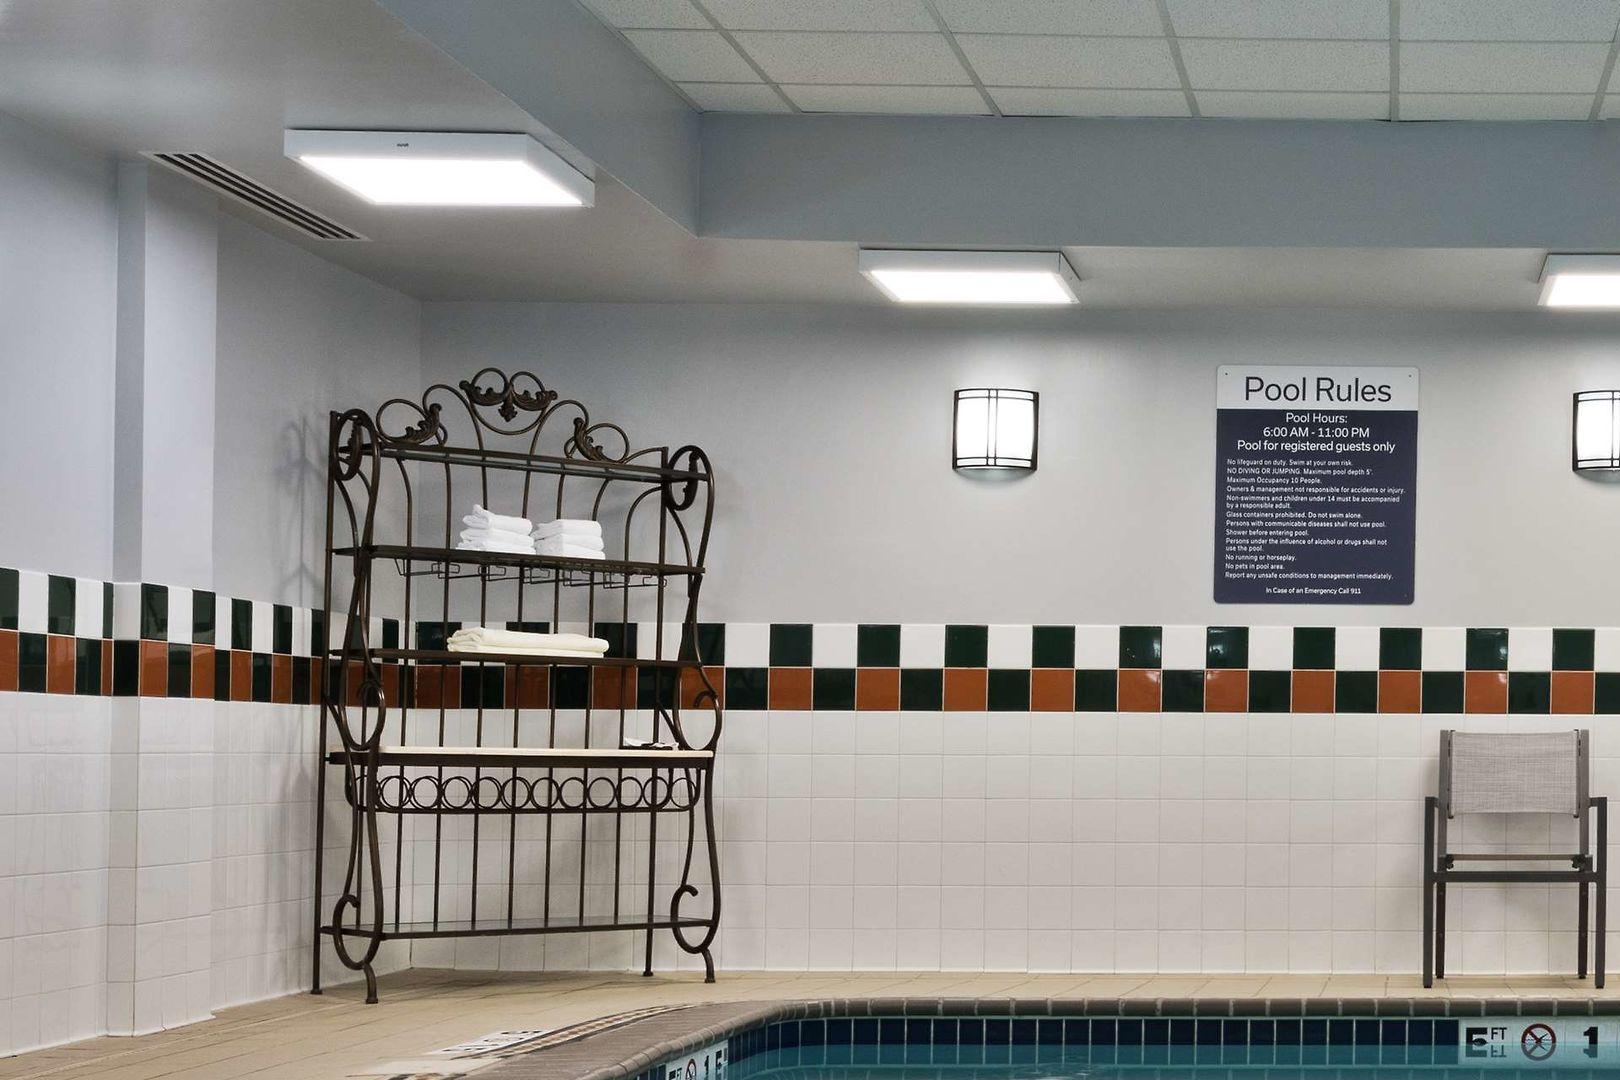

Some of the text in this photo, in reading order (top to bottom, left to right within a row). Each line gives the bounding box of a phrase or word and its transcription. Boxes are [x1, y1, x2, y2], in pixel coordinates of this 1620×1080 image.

[1245, 376, 1392, 402] Pool Rules
[1285, 412, 1348, 424] Pool Hours:
[1263, 427, 1288, 437] 6:00
[1289, 427, 1309, 437] AM
[1318, 427, 1349, 438] 11:00
[1351, 428, 1370, 438] PM
[1237, 439, 1396, 453] Pool for registered guests only
[1310, 572, 1316, 580] to
[1318, 572, 1355, 580] management
